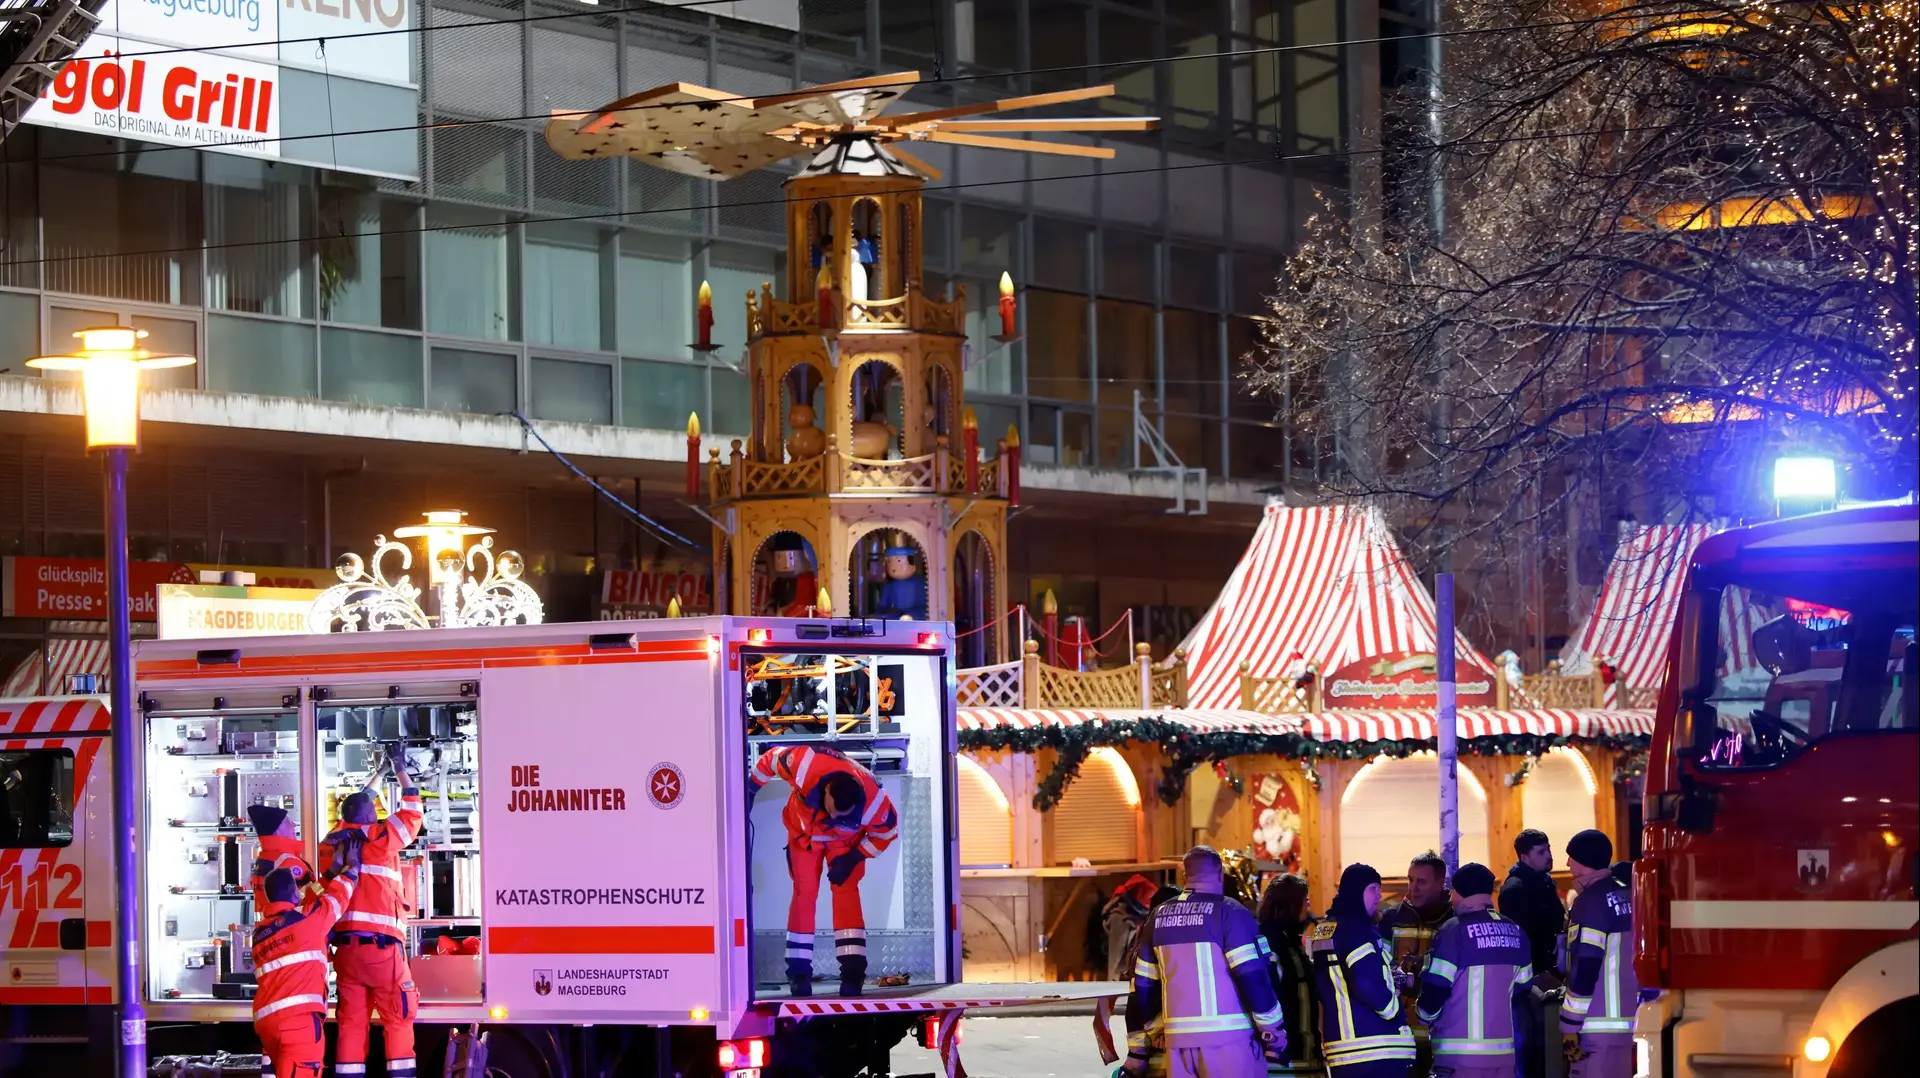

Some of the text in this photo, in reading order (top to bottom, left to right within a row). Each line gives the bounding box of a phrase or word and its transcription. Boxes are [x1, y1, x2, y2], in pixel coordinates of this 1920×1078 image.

[41, 49, 273, 134] göl Grill
[94, 111, 267, 151] DAS ORIGINAL AM ALTEN MARKT
[38, 565, 104, 586] Glückspilz
[37, 589, 93, 611] Presse
[188, 609, 305, 631] MAGDEBURGER
[511, 765, 540, 787] DIE
[507, 788, 626, 812] JOHANNITER
[1, 861, 83, 910] 112
[495, 888, 705, 905] KATASTROPHENSCHUTZ
[1154, 914, 1204, 929] MAGDEBURG
[557, 969, 669, 980] LANDESHAUPTSTADT
[557, 985, 627, 996] MAGDEBURG
